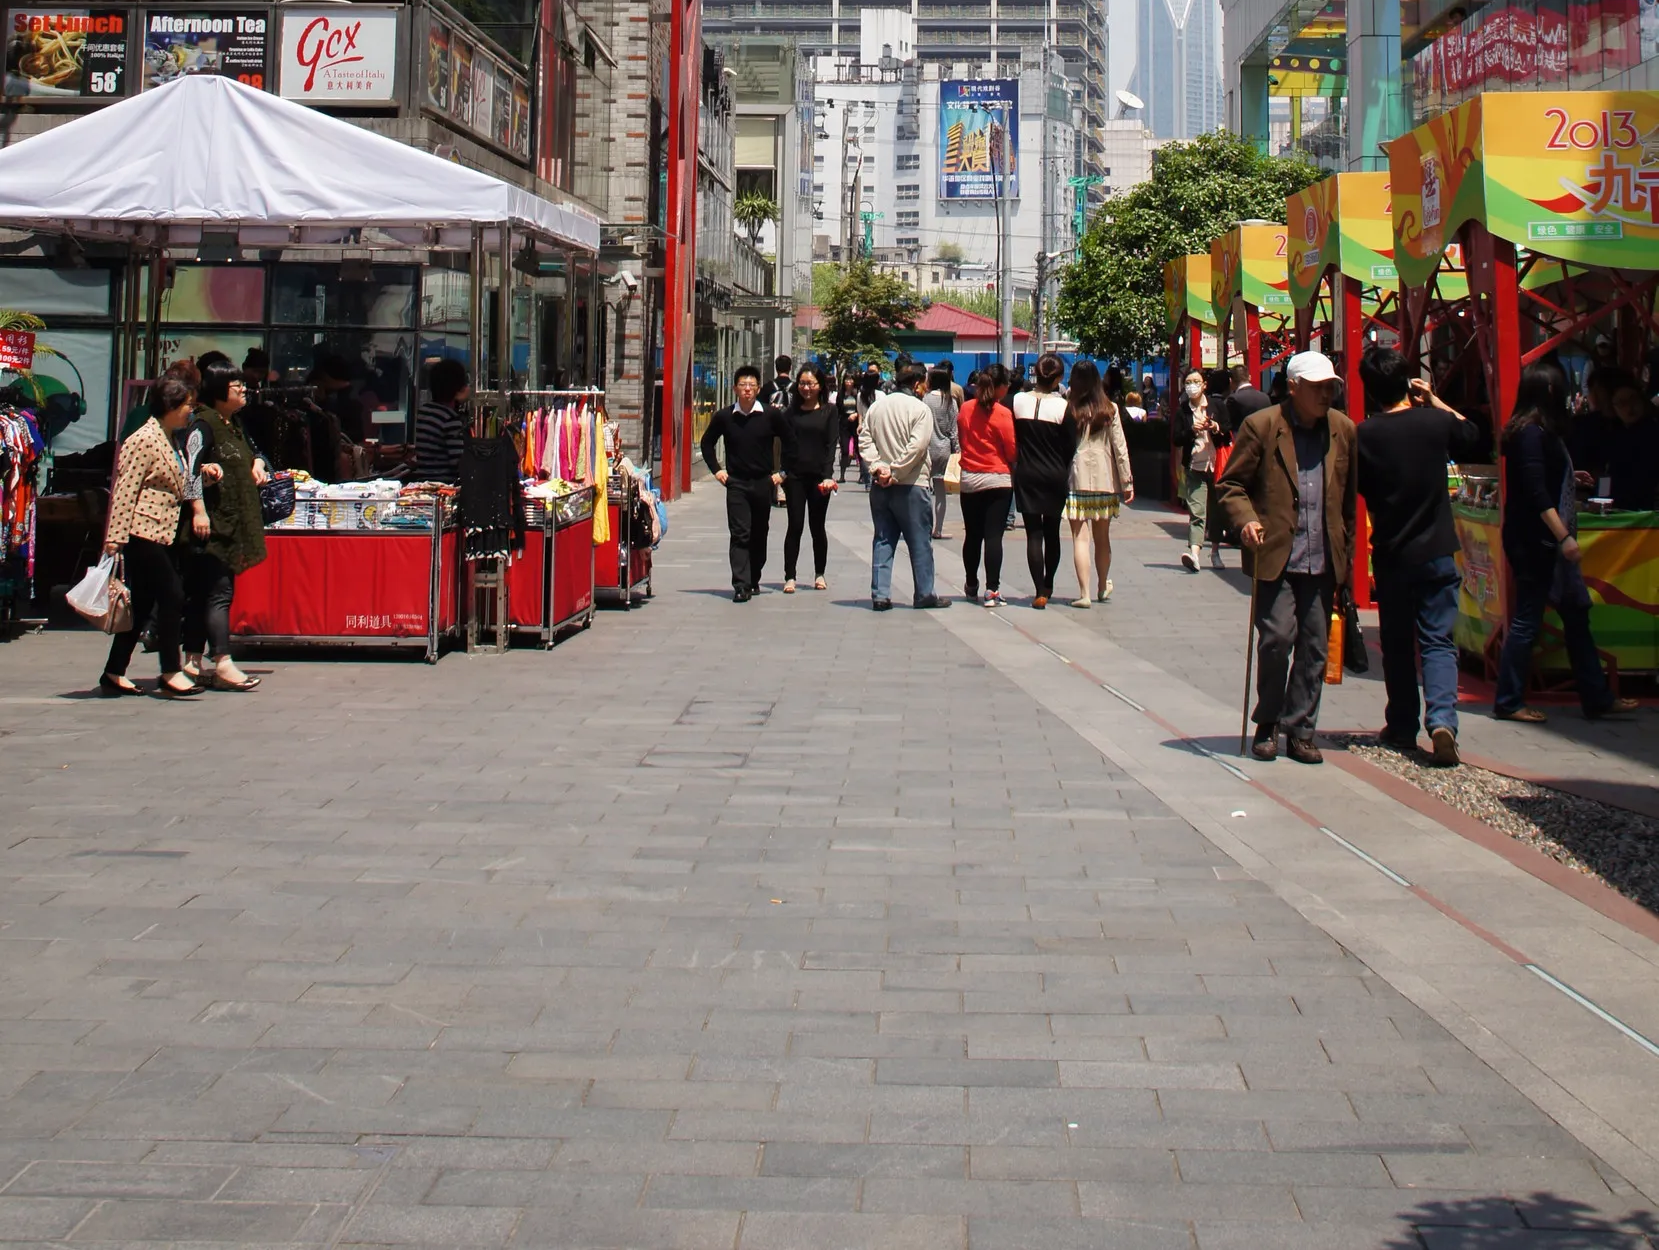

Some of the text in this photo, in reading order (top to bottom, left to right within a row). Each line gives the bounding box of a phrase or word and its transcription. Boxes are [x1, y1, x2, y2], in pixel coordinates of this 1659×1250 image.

[14, 14, 123, 33] Set Lunch
[151, 16, 265, 33] Afternoon Tea
[323, 70, 386, 82] A Taste of Italy
[1544, 107, 1640, 149] 2013
[346, 614, 392, 629] 同利道具
